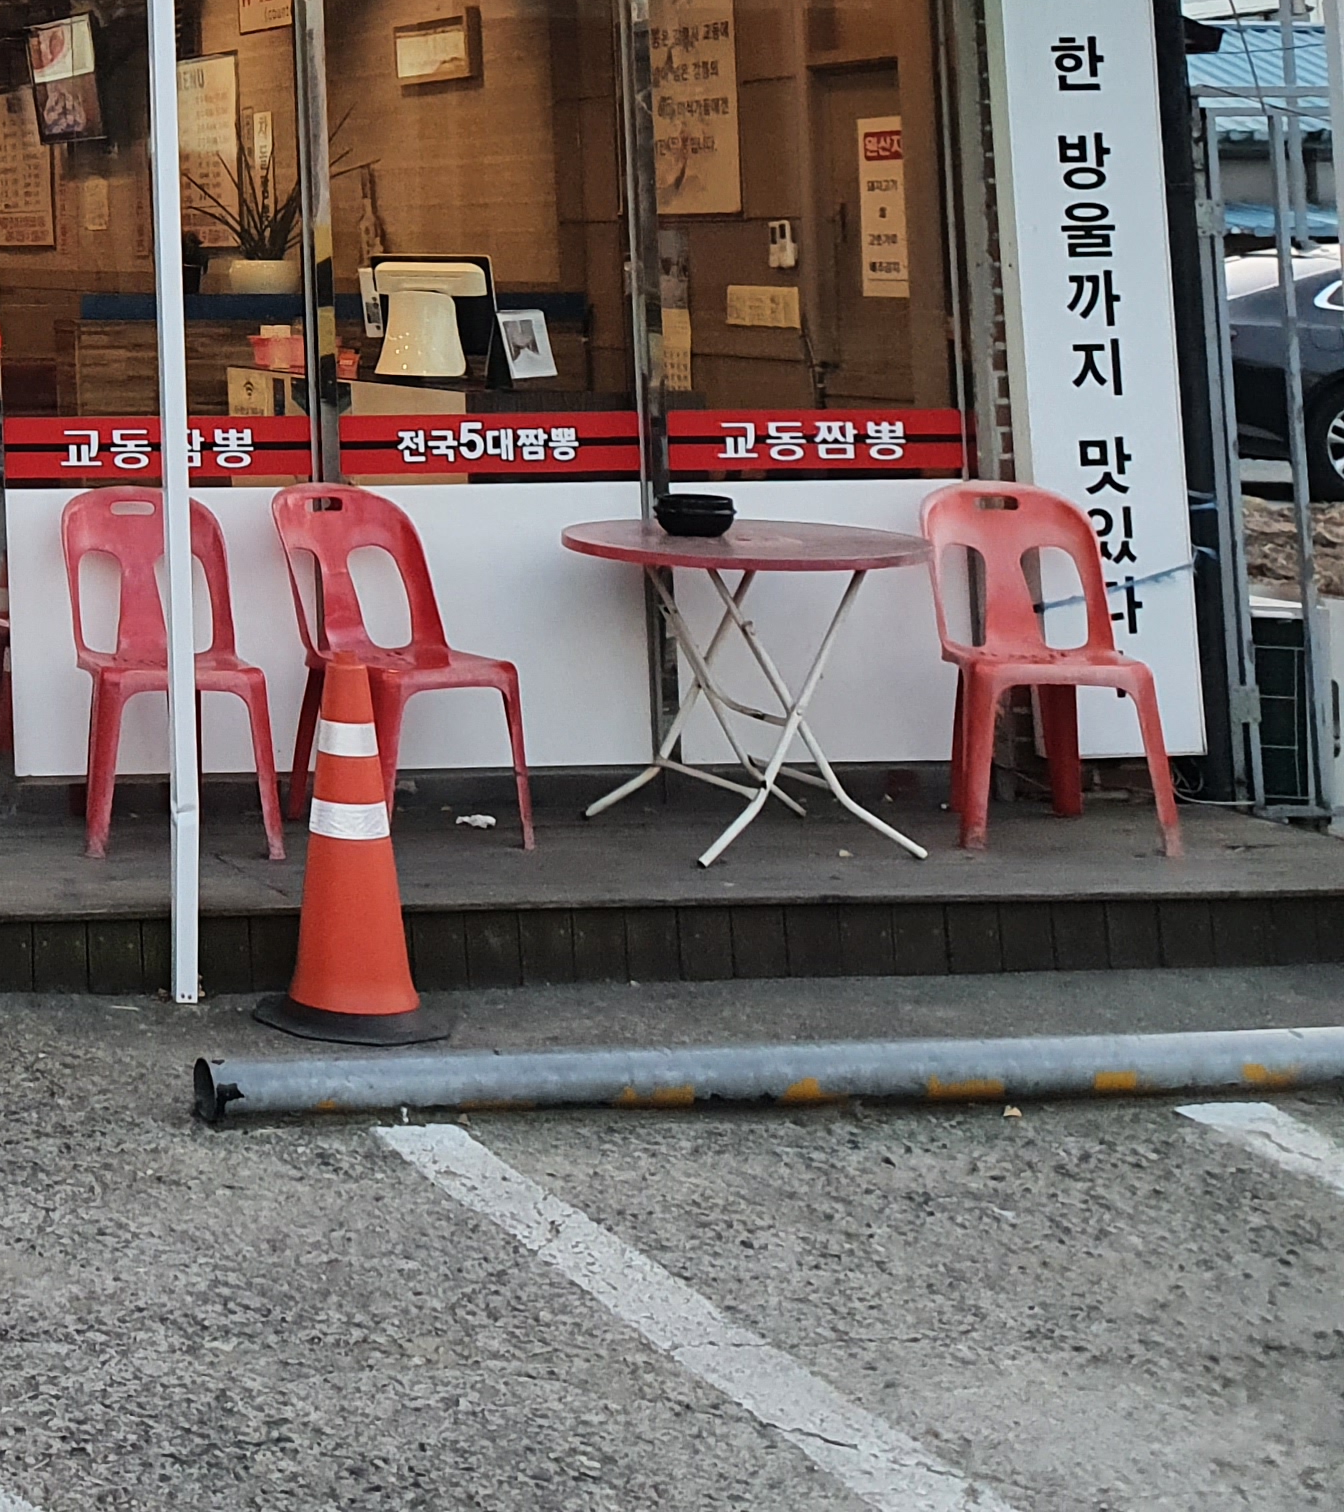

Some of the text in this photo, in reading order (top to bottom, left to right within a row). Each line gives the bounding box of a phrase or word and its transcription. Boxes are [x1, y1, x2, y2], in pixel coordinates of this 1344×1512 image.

[1051, 36, 1105, 91] 한
[1058, 132, 1124, 396] 방울까지
[397, 421, 579, 463] 전국5대짬뽕
[717, 421, 907, 462] 교동짬뽕
[1079, 437, 1144, 697] 맛있다
